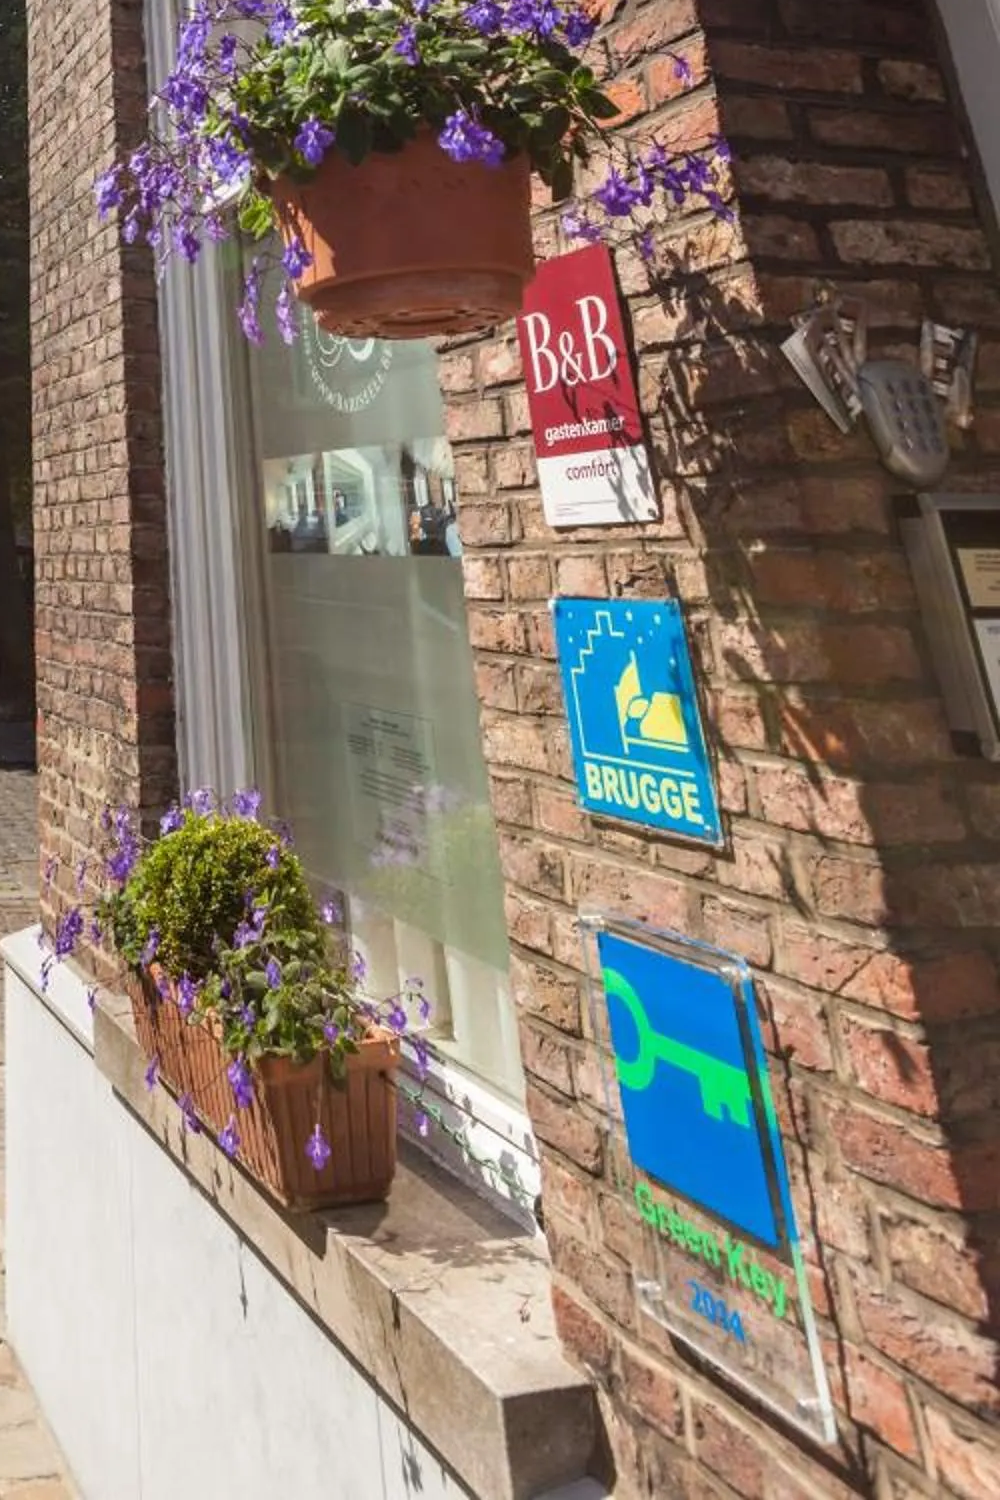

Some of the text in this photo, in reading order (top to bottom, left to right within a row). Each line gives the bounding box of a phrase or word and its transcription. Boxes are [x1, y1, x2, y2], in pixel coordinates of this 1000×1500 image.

[523, 296, 617, 393] B&B
[545, 416, 625, 446] gastenkamer
[565, 457, 618, 481] comfort
[584, 762, 704, 824] BRUGGE
[635, 1182, 785, 1317] Green Key
